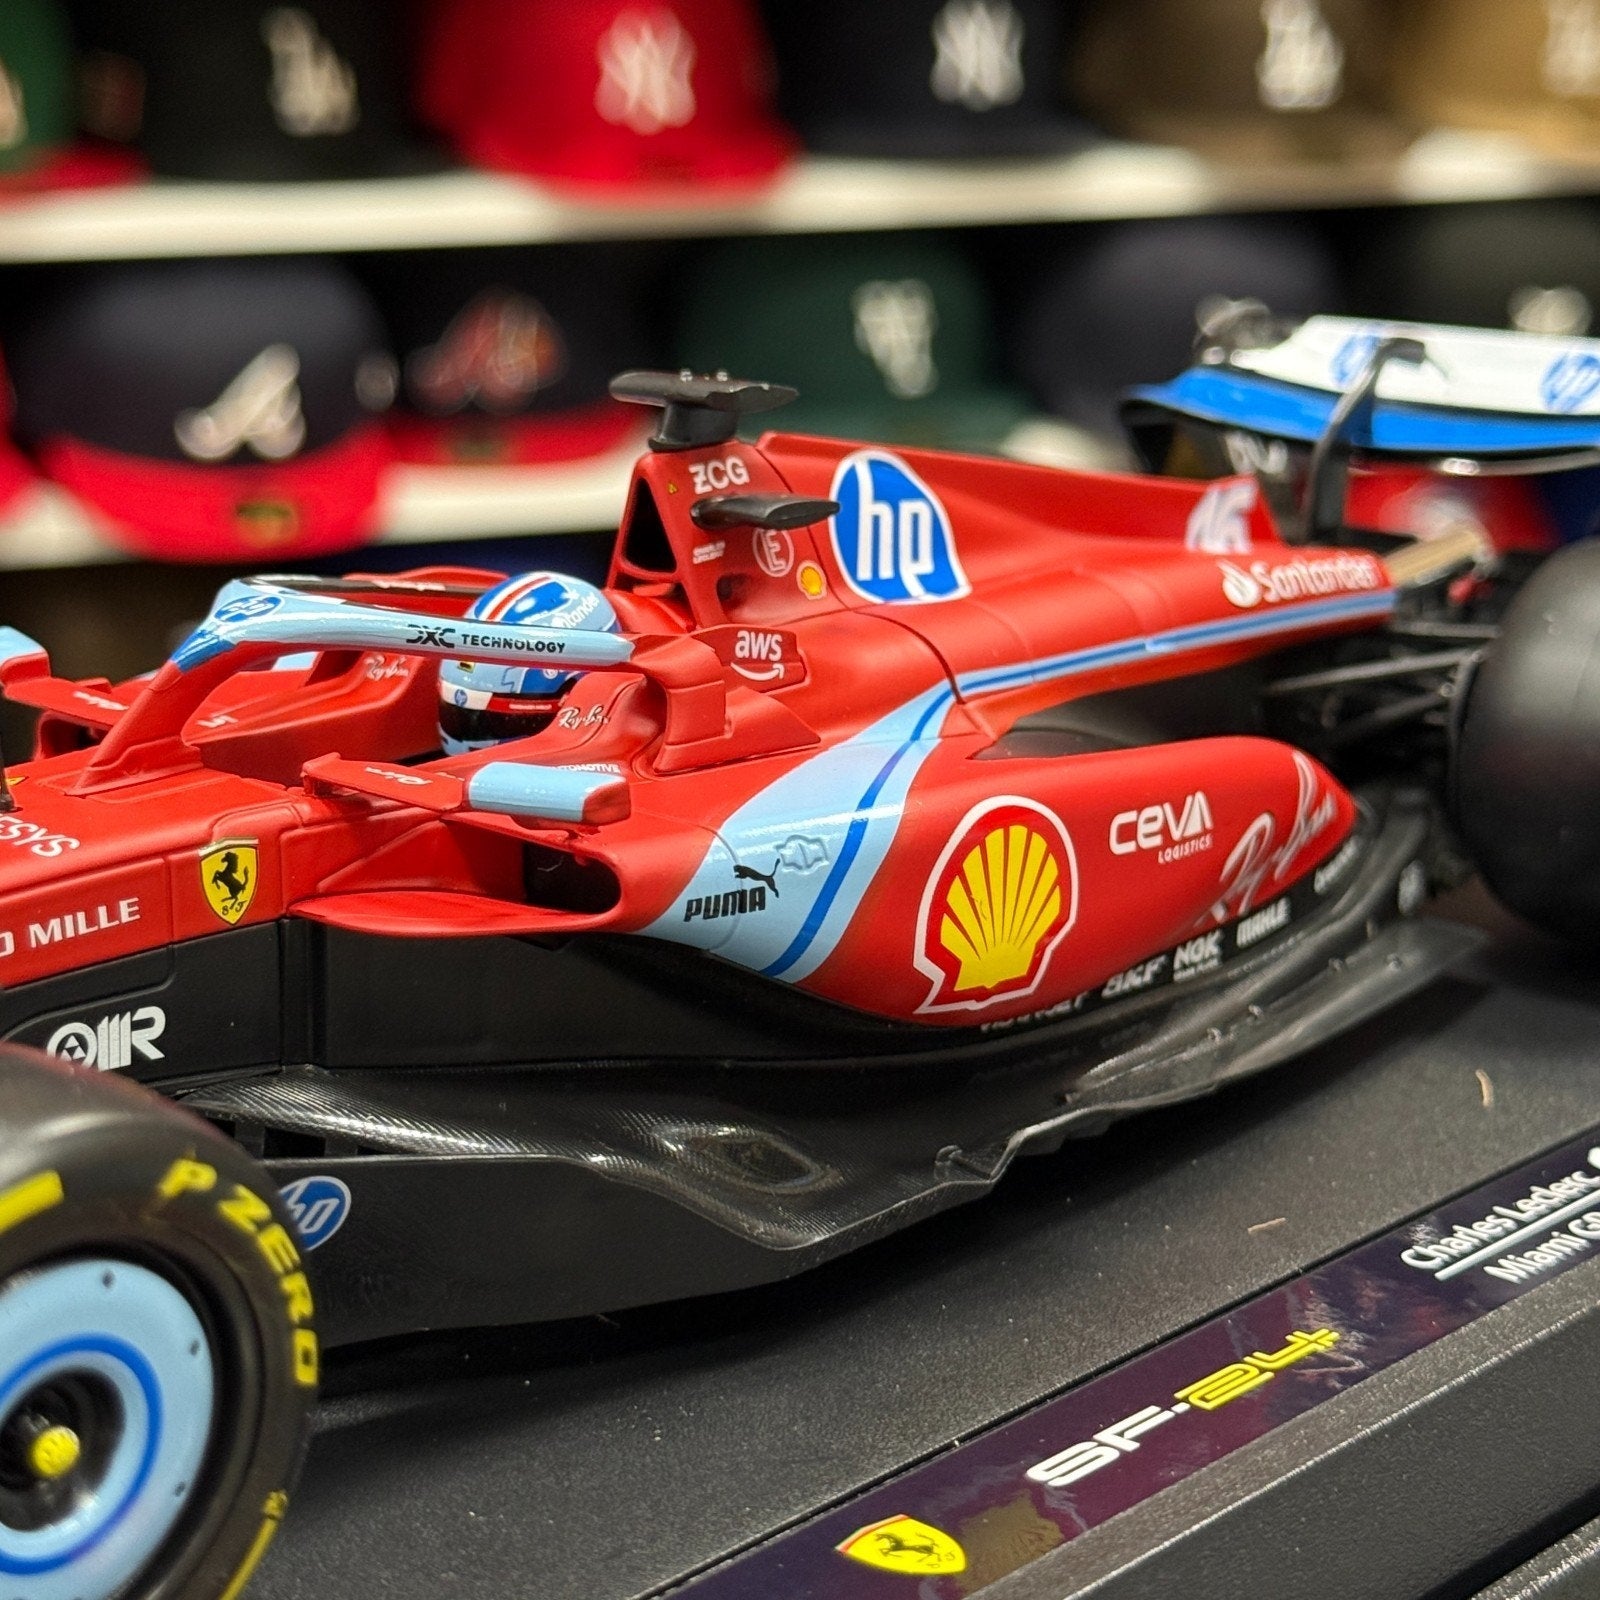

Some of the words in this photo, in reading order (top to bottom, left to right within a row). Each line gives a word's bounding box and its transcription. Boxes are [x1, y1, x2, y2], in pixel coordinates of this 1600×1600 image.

[688, 456, 750, 494] ZCG
[855, 456, 936, 598] hp
[1250, 556, 1379, 602] Santander
[405, 624, 456, 648] DXC
[461, 633, 566, 653] TECHNOLOGY
[735, 630, 783, 662] aws
[28, 897, 141, 948] MILLE
[683, 887, 766, 922] PUMA
[1401, 1214, 1519, 1270] Charles
[1492, 1170, 1600, 1223] Leclerc
[1483, 1230, 1592, 1285] Miami
[217, 1183, 320, 1387] ZERO
